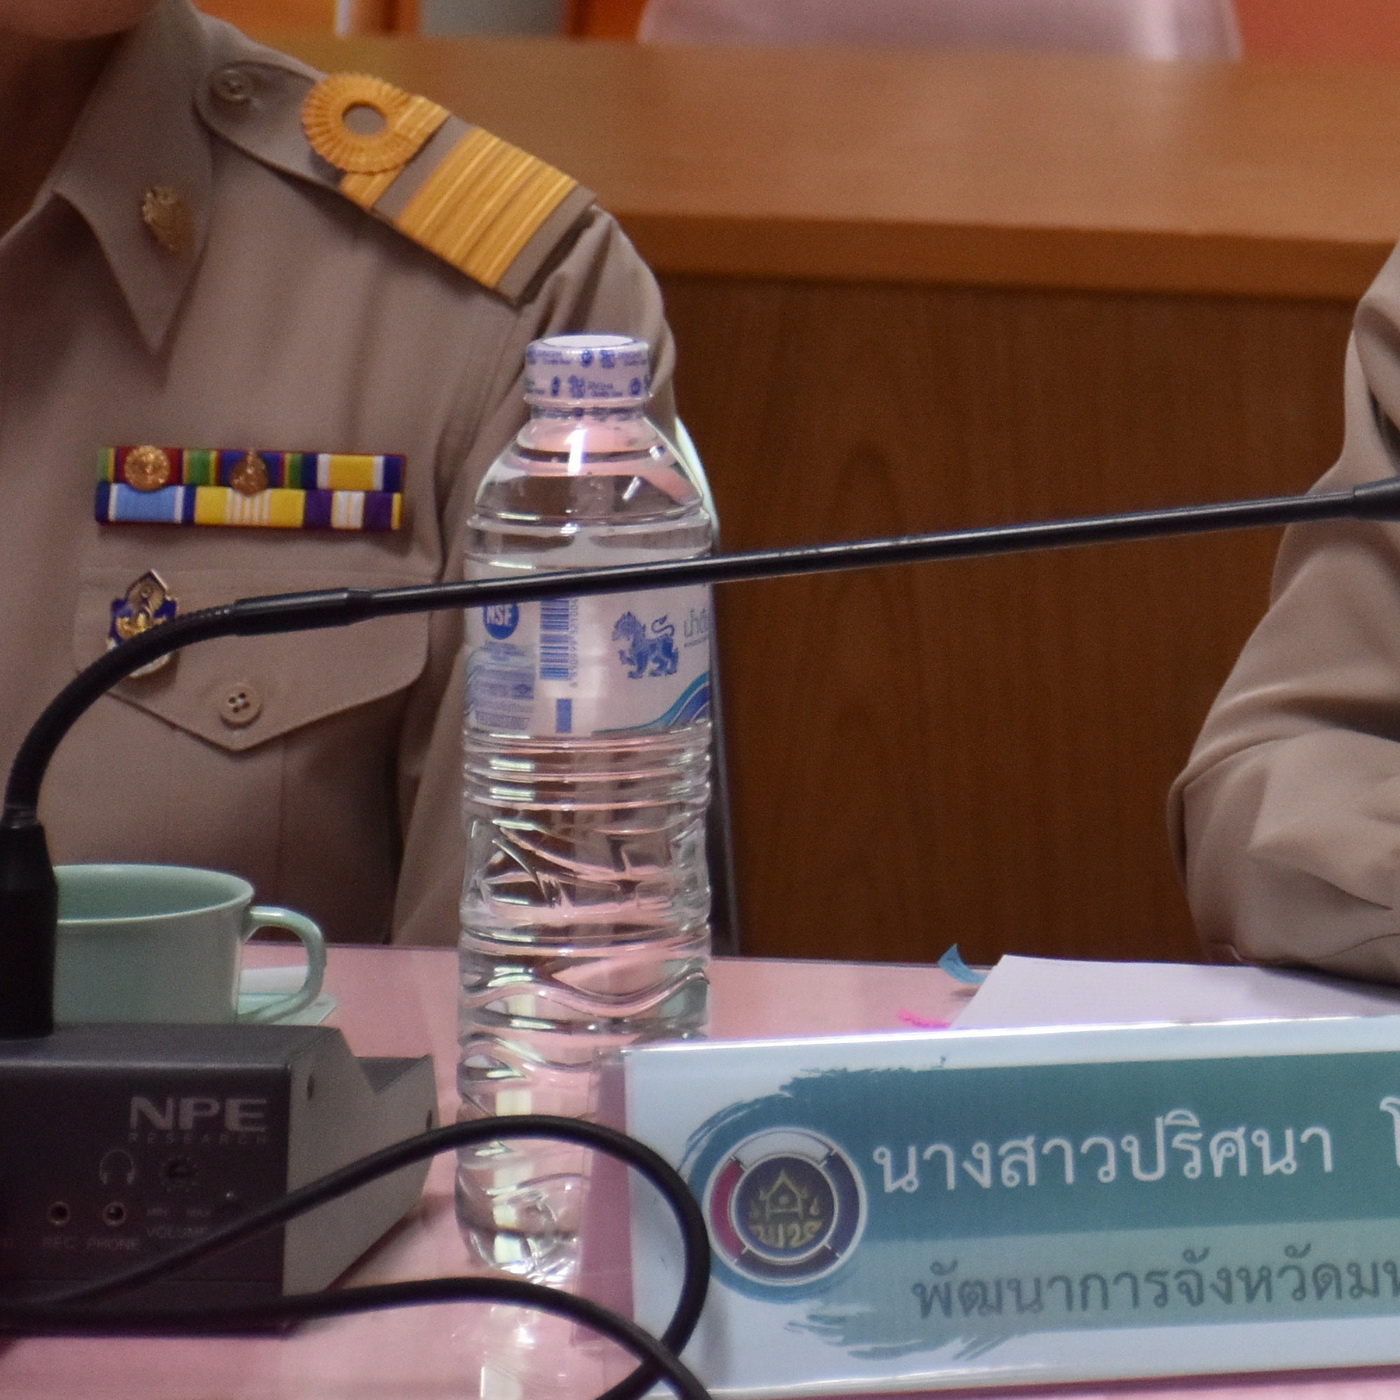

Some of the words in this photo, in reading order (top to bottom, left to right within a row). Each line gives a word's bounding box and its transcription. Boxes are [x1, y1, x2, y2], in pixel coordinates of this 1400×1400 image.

[129, 1095, 268, 1133] NPE
[129, 1133, 268, 1145] RESEARCH
[873, 1109, 1333, 1194] นางสาวปริศนา
